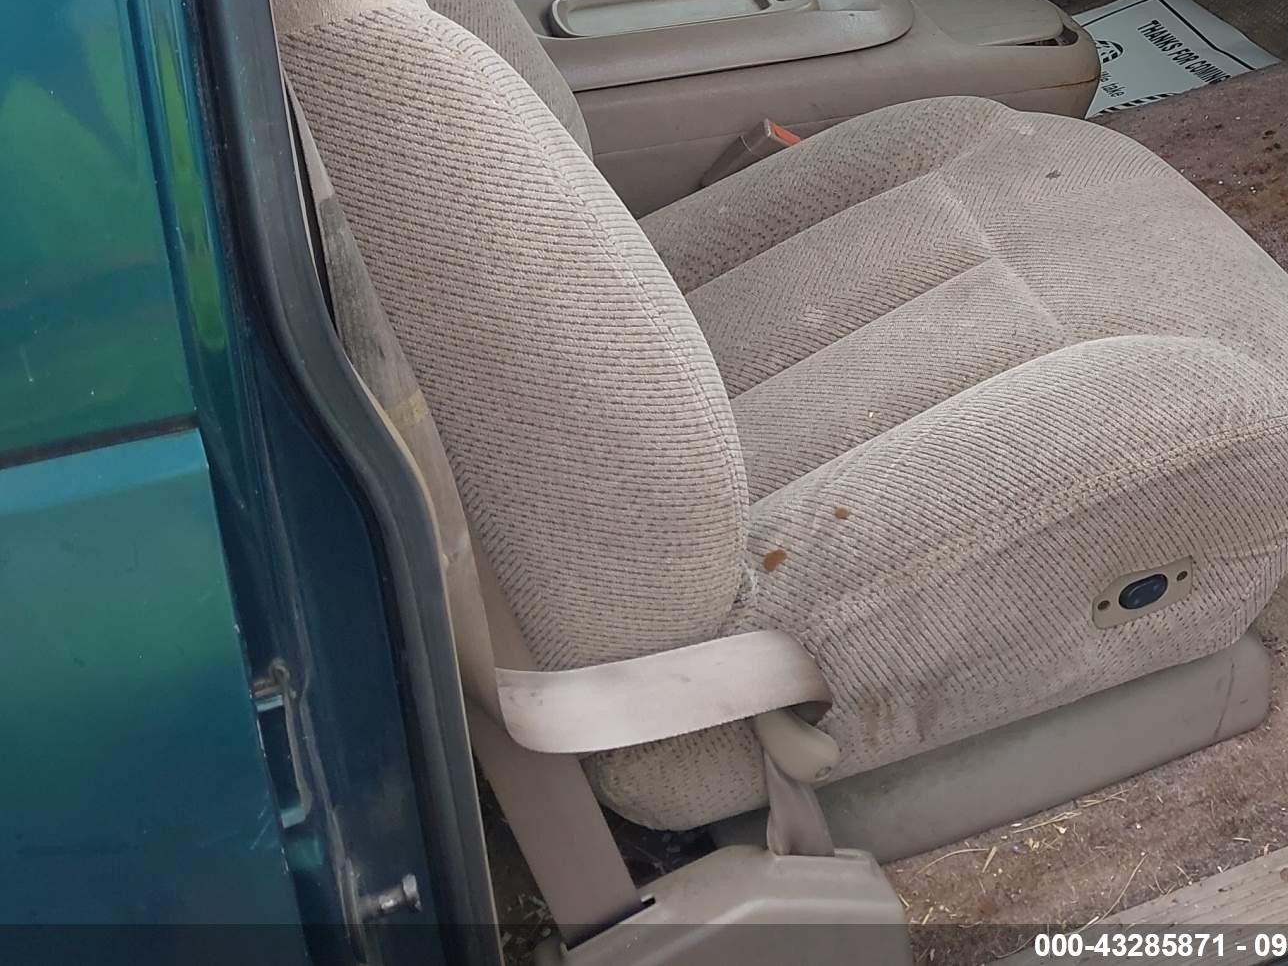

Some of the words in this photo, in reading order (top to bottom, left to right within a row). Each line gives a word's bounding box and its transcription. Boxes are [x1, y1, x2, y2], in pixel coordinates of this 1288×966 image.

[1137, 19, 1183, 51] THANKS
[1168, 48, 1200, 65] FOR
[1101, 82, 1126, 98] take
